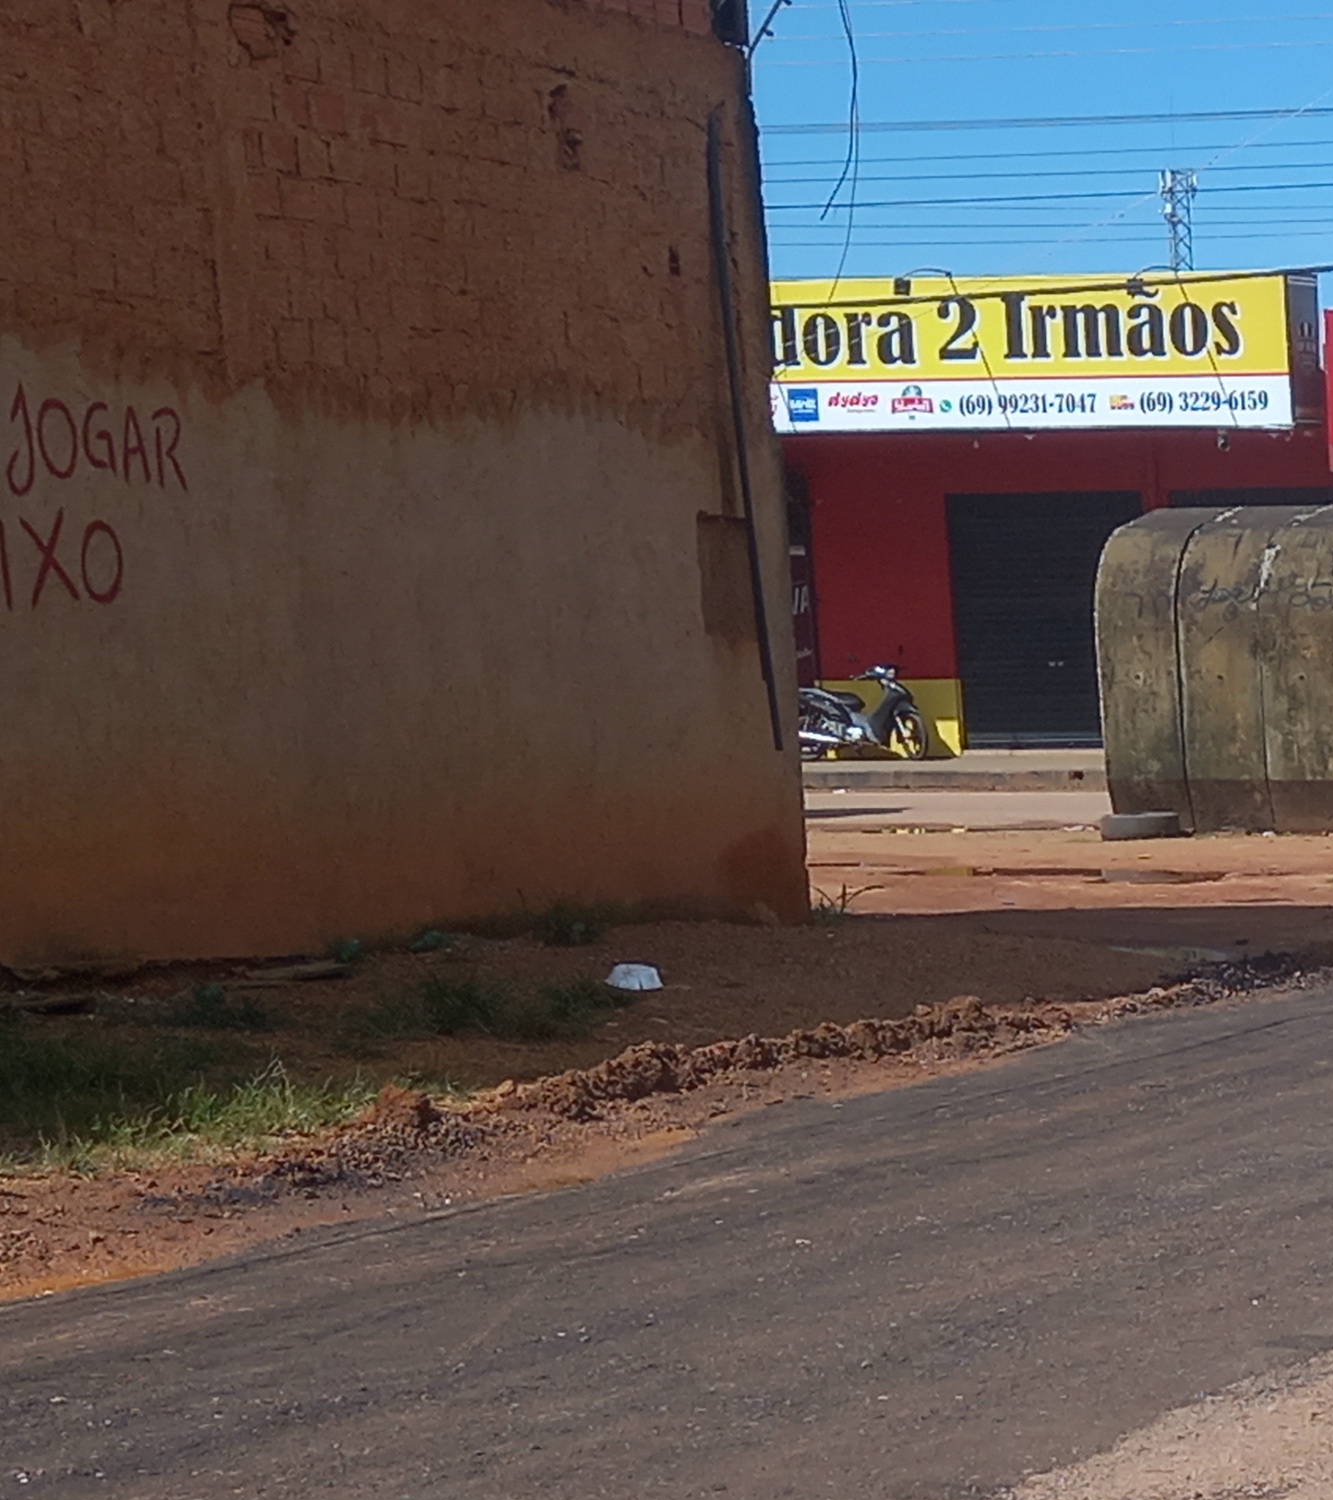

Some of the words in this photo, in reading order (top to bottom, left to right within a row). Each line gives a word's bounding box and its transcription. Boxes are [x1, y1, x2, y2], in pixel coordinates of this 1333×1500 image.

[937, 299, 980, 361] 2
[1003, 283, 1241, 360] Irmãos
[958, 394, 993, 416] (69)
[997, 392, 1098, 414] 99231-7047
[1139, 391, 1174, 414] (69)
[1178, 389, 1269, 412] 3229-6159
[6, 380, 189, 496] JOGAR
